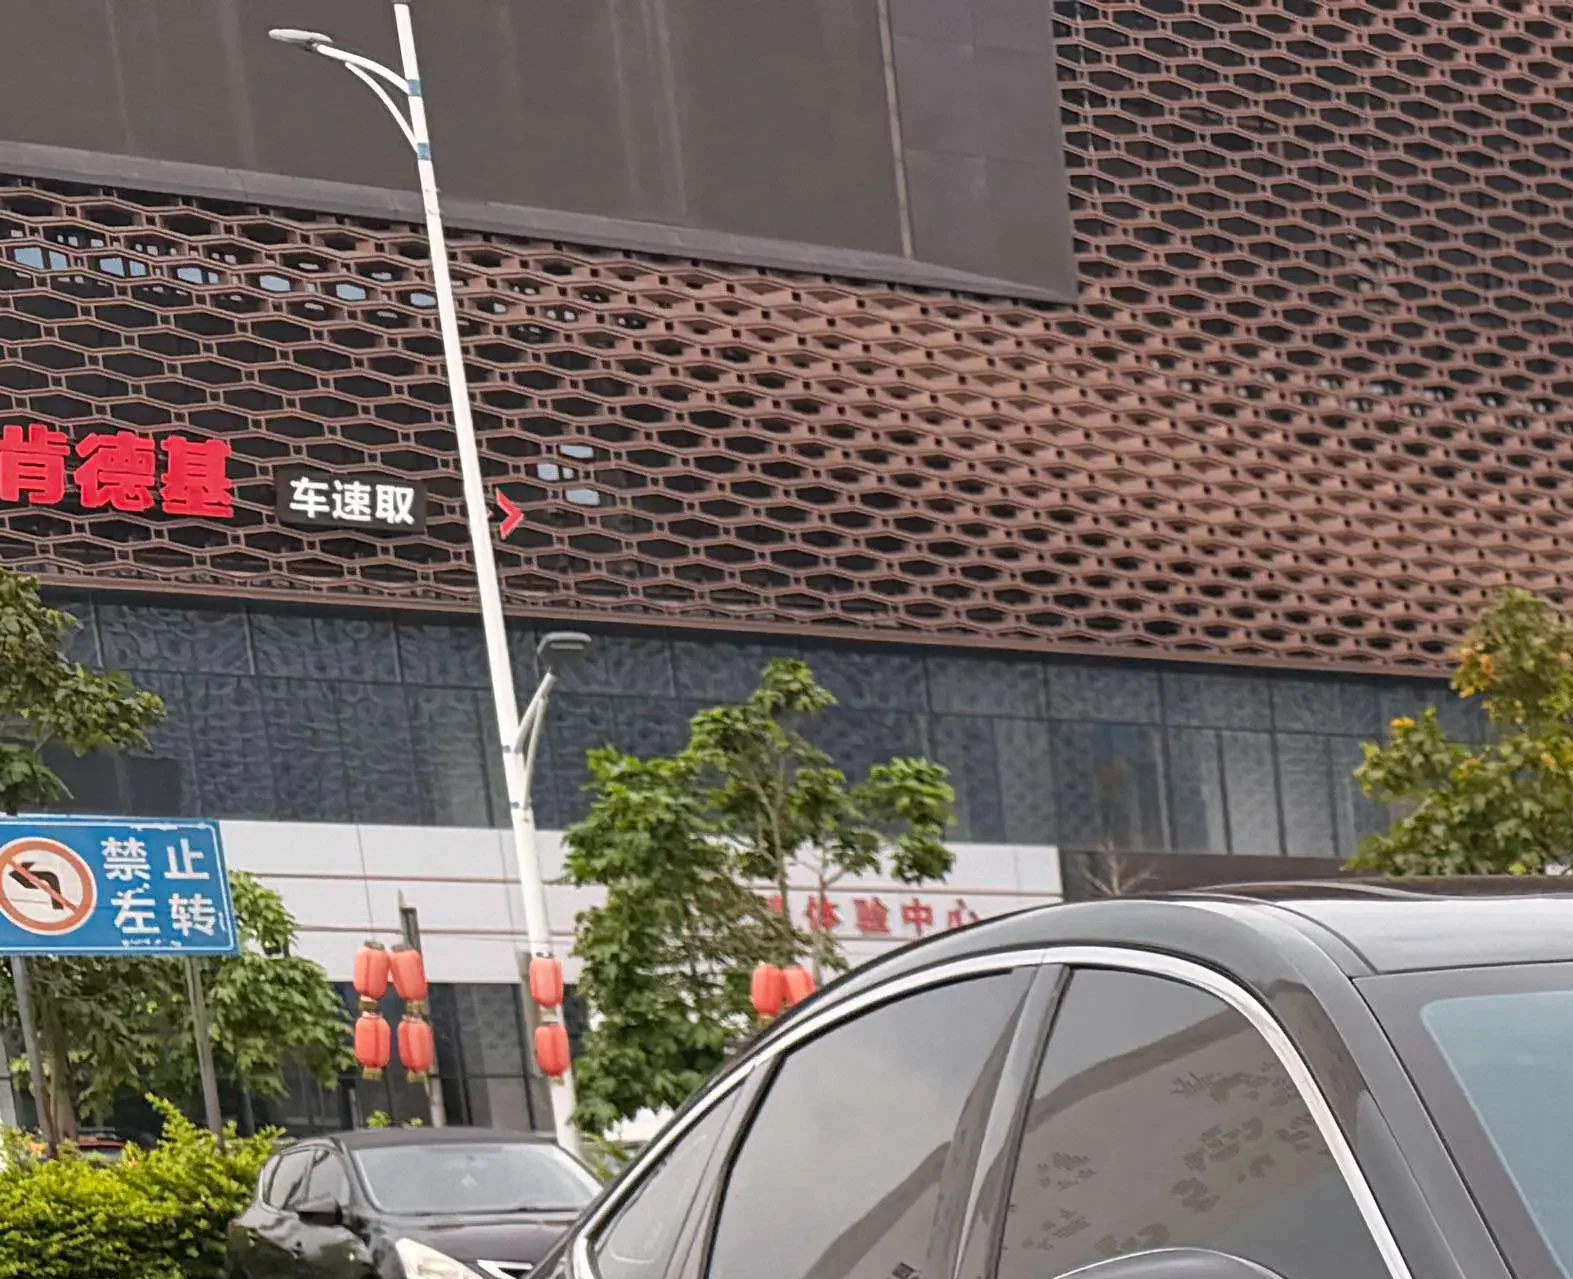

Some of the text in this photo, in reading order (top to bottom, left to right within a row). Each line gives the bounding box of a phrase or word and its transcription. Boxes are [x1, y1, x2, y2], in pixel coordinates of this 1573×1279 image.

[0, 424, 234, 519] 肯德基
[289, 477, 416, 525] 车速取
[101, 836, 211, 882] 禁止
[110, 888, 217, 938] 左转
